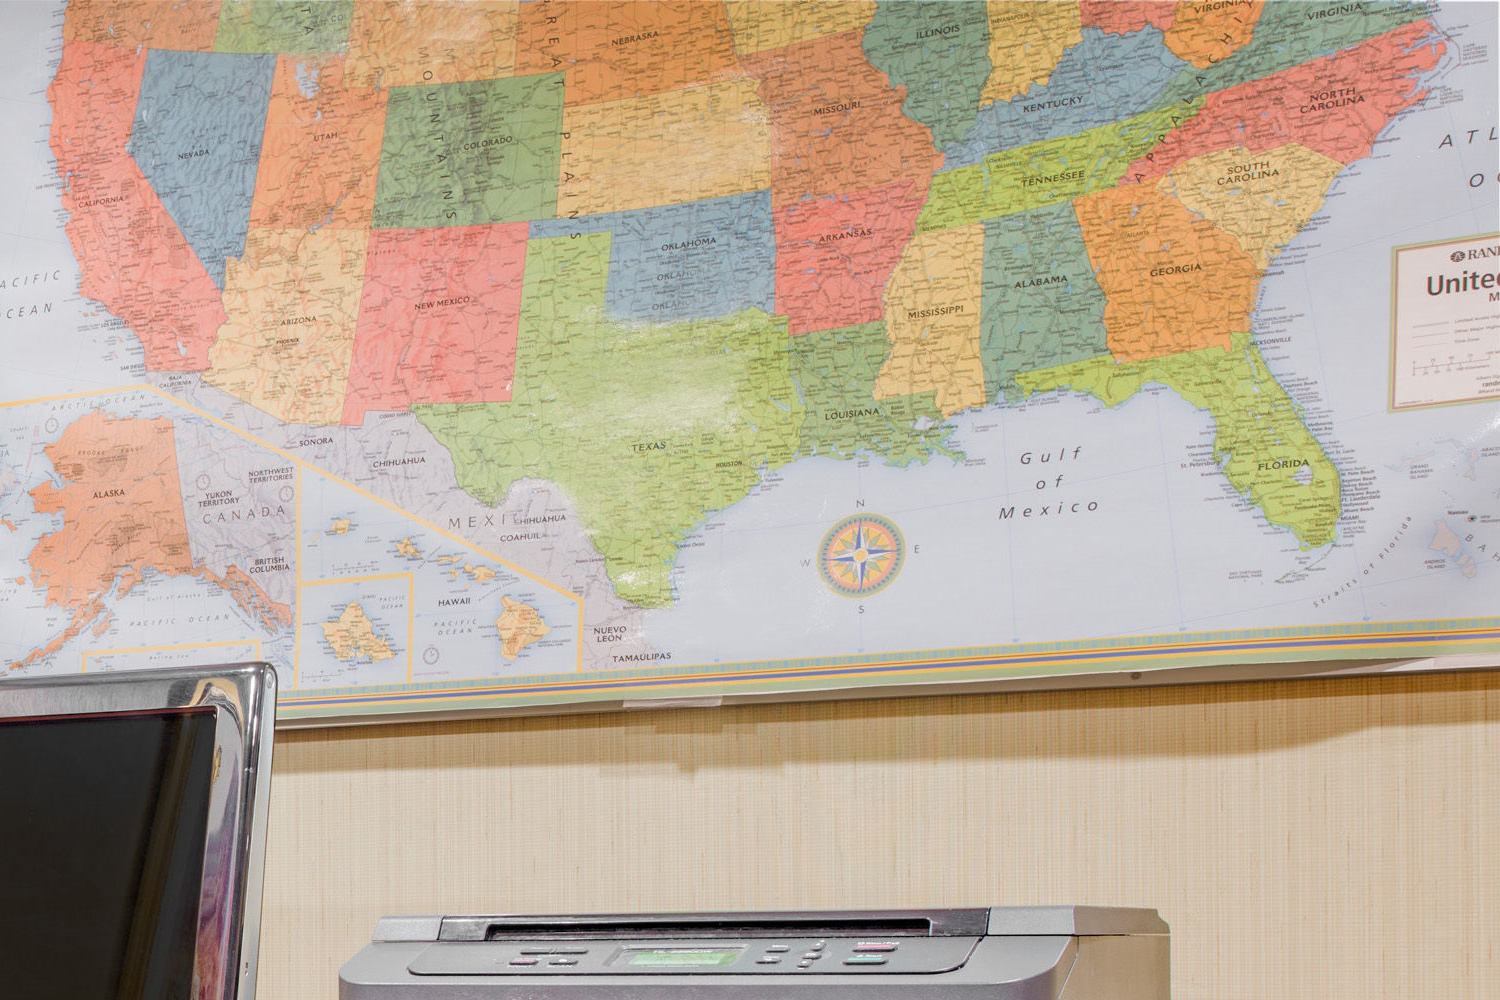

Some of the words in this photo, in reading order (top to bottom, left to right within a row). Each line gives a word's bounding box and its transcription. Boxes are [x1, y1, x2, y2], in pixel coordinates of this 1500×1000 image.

[1194, 0, 1246, 14] VIRGINIA
[1307, 3, 1363, 20] VIRGINIA
[611, 30, 659, 46] NEBRASKA
[915, 24, 960, 40] ILLINOIS
[1309, 87, 1356, 103] NORTH
[812, 101, 861, 116] MISSOURI
[1023, 95, 1084, 113] KENTUCKY
[1300, 95, 1365, 114] CAROLINA
[313, 131, 338, 142] UTAH
[463, 135, 513, 151] COLORADO
[177, 148, 210, 160] NEVADA
[1227, 160, 1270, 175] SOUTH
[1021, 169, 1085, 188] TENNESSEE
[1217, 168, 1279, 186] CAROLINA
[561, 131, 584, 240] PLAINS
[78, 195, 125, 208] CALIFORNIA
[818, 228, 873, 244] ARKANSAS
[661, 236, 717, 252] OKLAHOMA
[1150, 263, 1202, 277] GEORGIA
[1014, 274, 1068, 290] ALABAMA
[414, 300, 435, 311] NEW
[437, 295, 470, 308] MEXICO
[907, 305, 964, 320] MISSISSIPPI
[280, 315, 317, 327] ARIZONA
[824, 407, 879, 421] LOUISIANA
[299, 436, 334, 447] SONORA
[631, 441, 667, 452] TEXAS
[373, 456, 426, 468] CHIHUAHUA
[1020, 446, 1082, 465] Gulf
[715, 460, 742, 468] HOUSTON
[1257, 458, 1310, 471] FLORIDA
[248, 466, 294, 478] NORTHWEST
[249, 473, 293, 484] TERRITORIES
[1035, 475, 1065, 490] of
[92, 489, 125, 499] ALASKA
[205, 490, 232, 500] YUKON
[198, 496, 240, 508] TERRITORY
[856, 499, 865, 508] N
[203, 505, 285, 525] CANADA
[999, 500, 1099, 520] Mexico
[914, 544, 920, 553] E
[254, 556, 285, 566] BRITISH
[249, 563, 290, 574] COLUMBIA
[438, 597, 471, 607] HAWAII
[858, 605, 865, 614] S
[130, 617, 176, 627] PACIFIC
[188, 614, 230, 623] OCEAN
[593, 625, 627, 635] NUEVO
[612, 652, 671, 663] TAMAULIPAS
